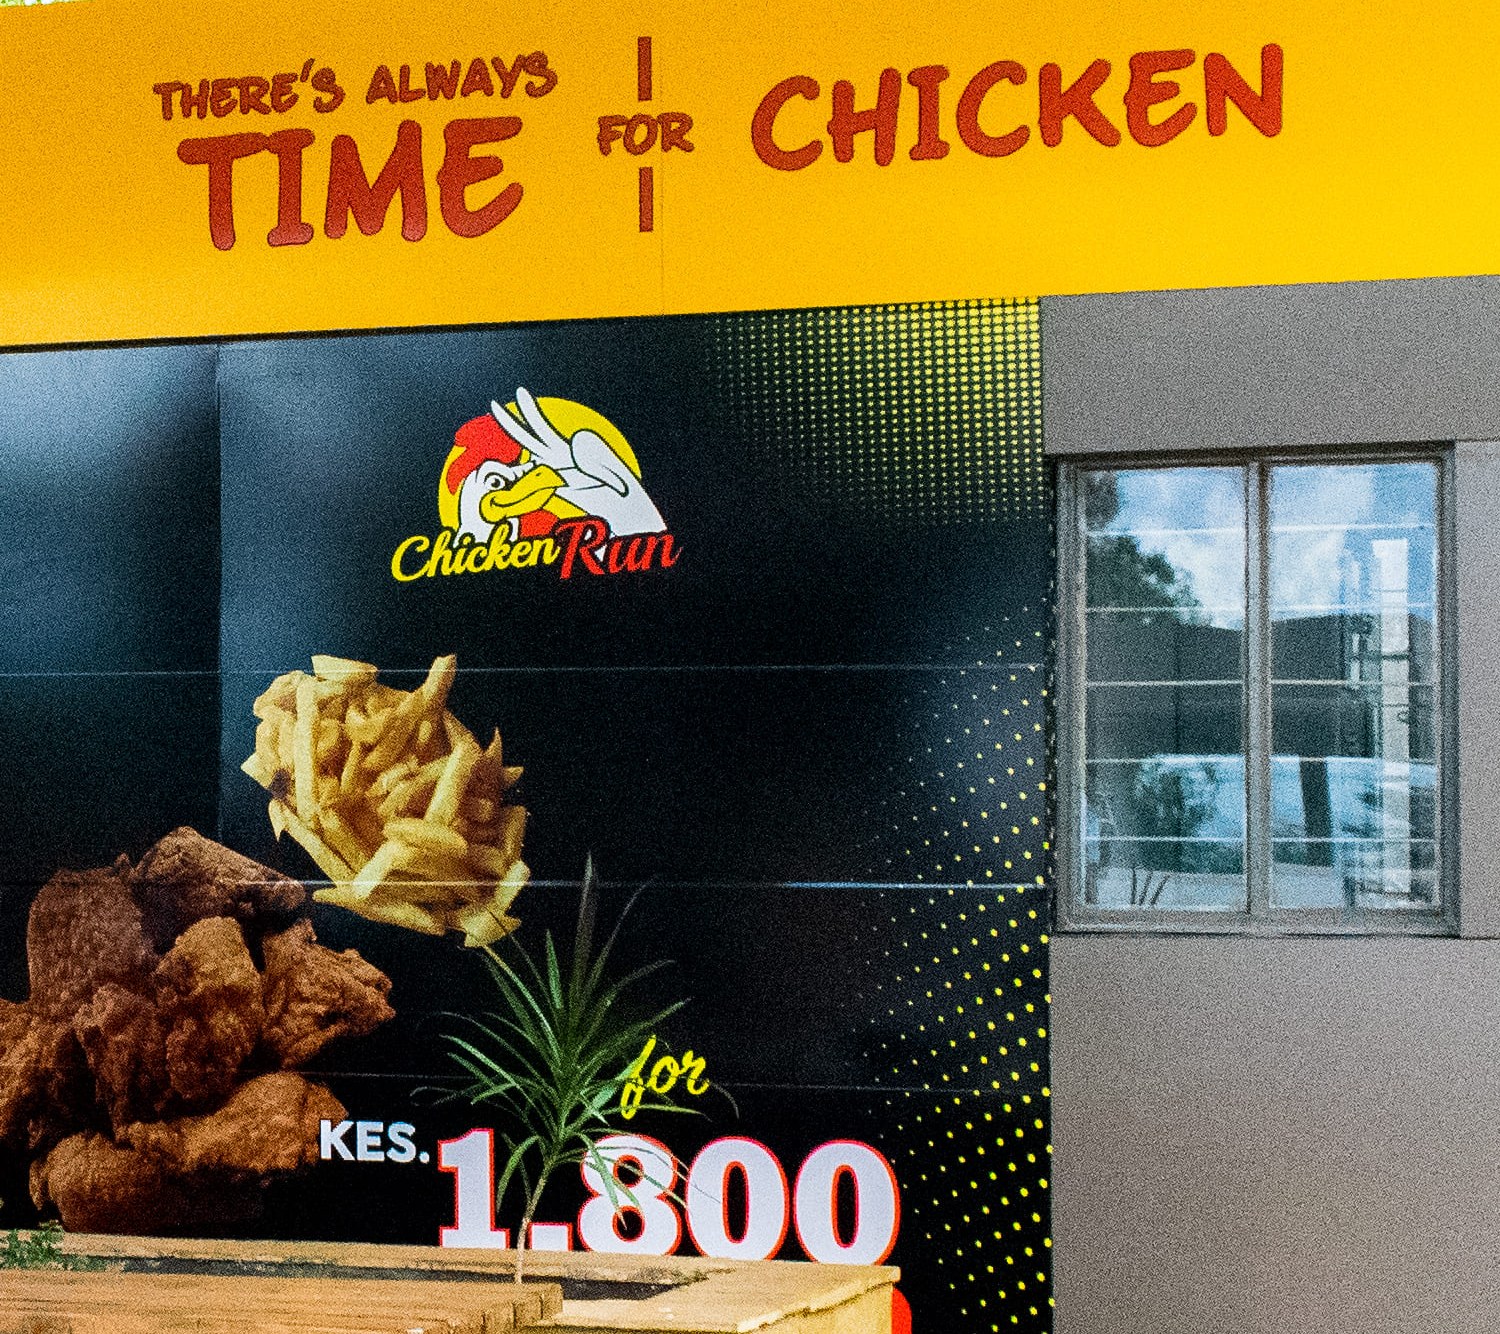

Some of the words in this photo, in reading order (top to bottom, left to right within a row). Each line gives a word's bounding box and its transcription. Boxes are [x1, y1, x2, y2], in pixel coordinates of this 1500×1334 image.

[153, 57, 345, 121] THERE'S
[365, 50, 558, 105] ALWAYS
[750, 43, 1285, 173] CHICKEN
[596, 112, 695, 157] FOR
[177, 116, 525, 251] TIME
[390, 523, 562, 582] Chicken
[556, 519, 685, 580] Run
[619, 1034, 711, 1121] for
[319, 1119, 431, 1165] KES.
